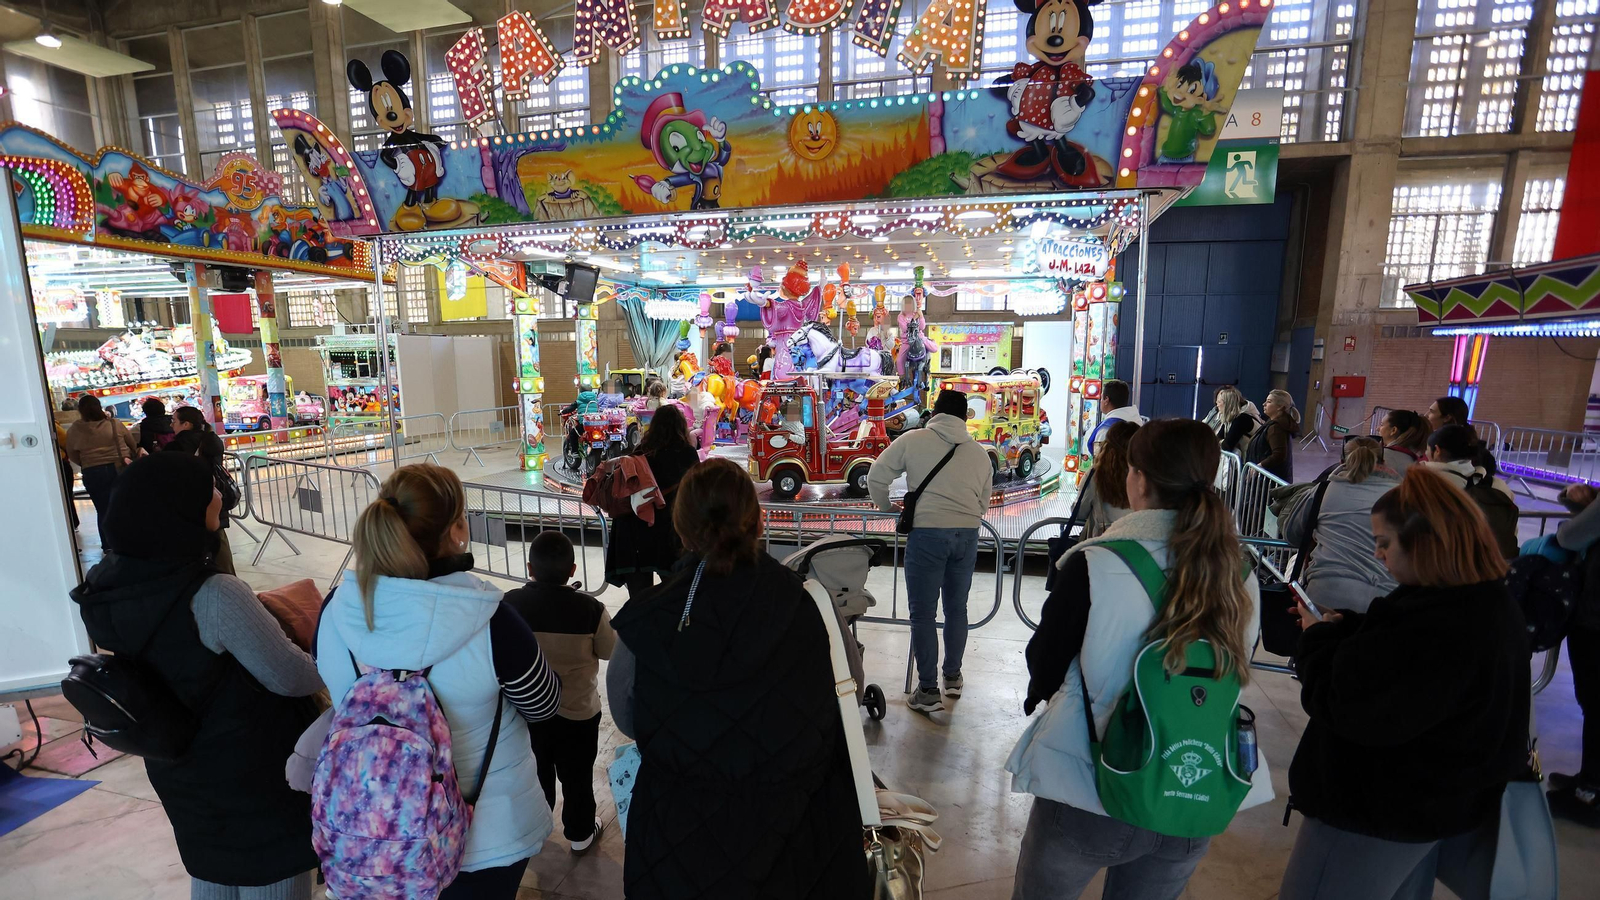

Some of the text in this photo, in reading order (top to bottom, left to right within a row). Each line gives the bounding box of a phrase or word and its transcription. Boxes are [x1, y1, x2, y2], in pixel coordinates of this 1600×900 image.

[1251, 111, 1261, 127] 8
[231, 171, 257, 199] 95
[1041, 239, 1103, 262] ATRACCIONES
[1074, 262, 1096, 276] LAZA
[1175, 790, 1193, 800] Serrano
